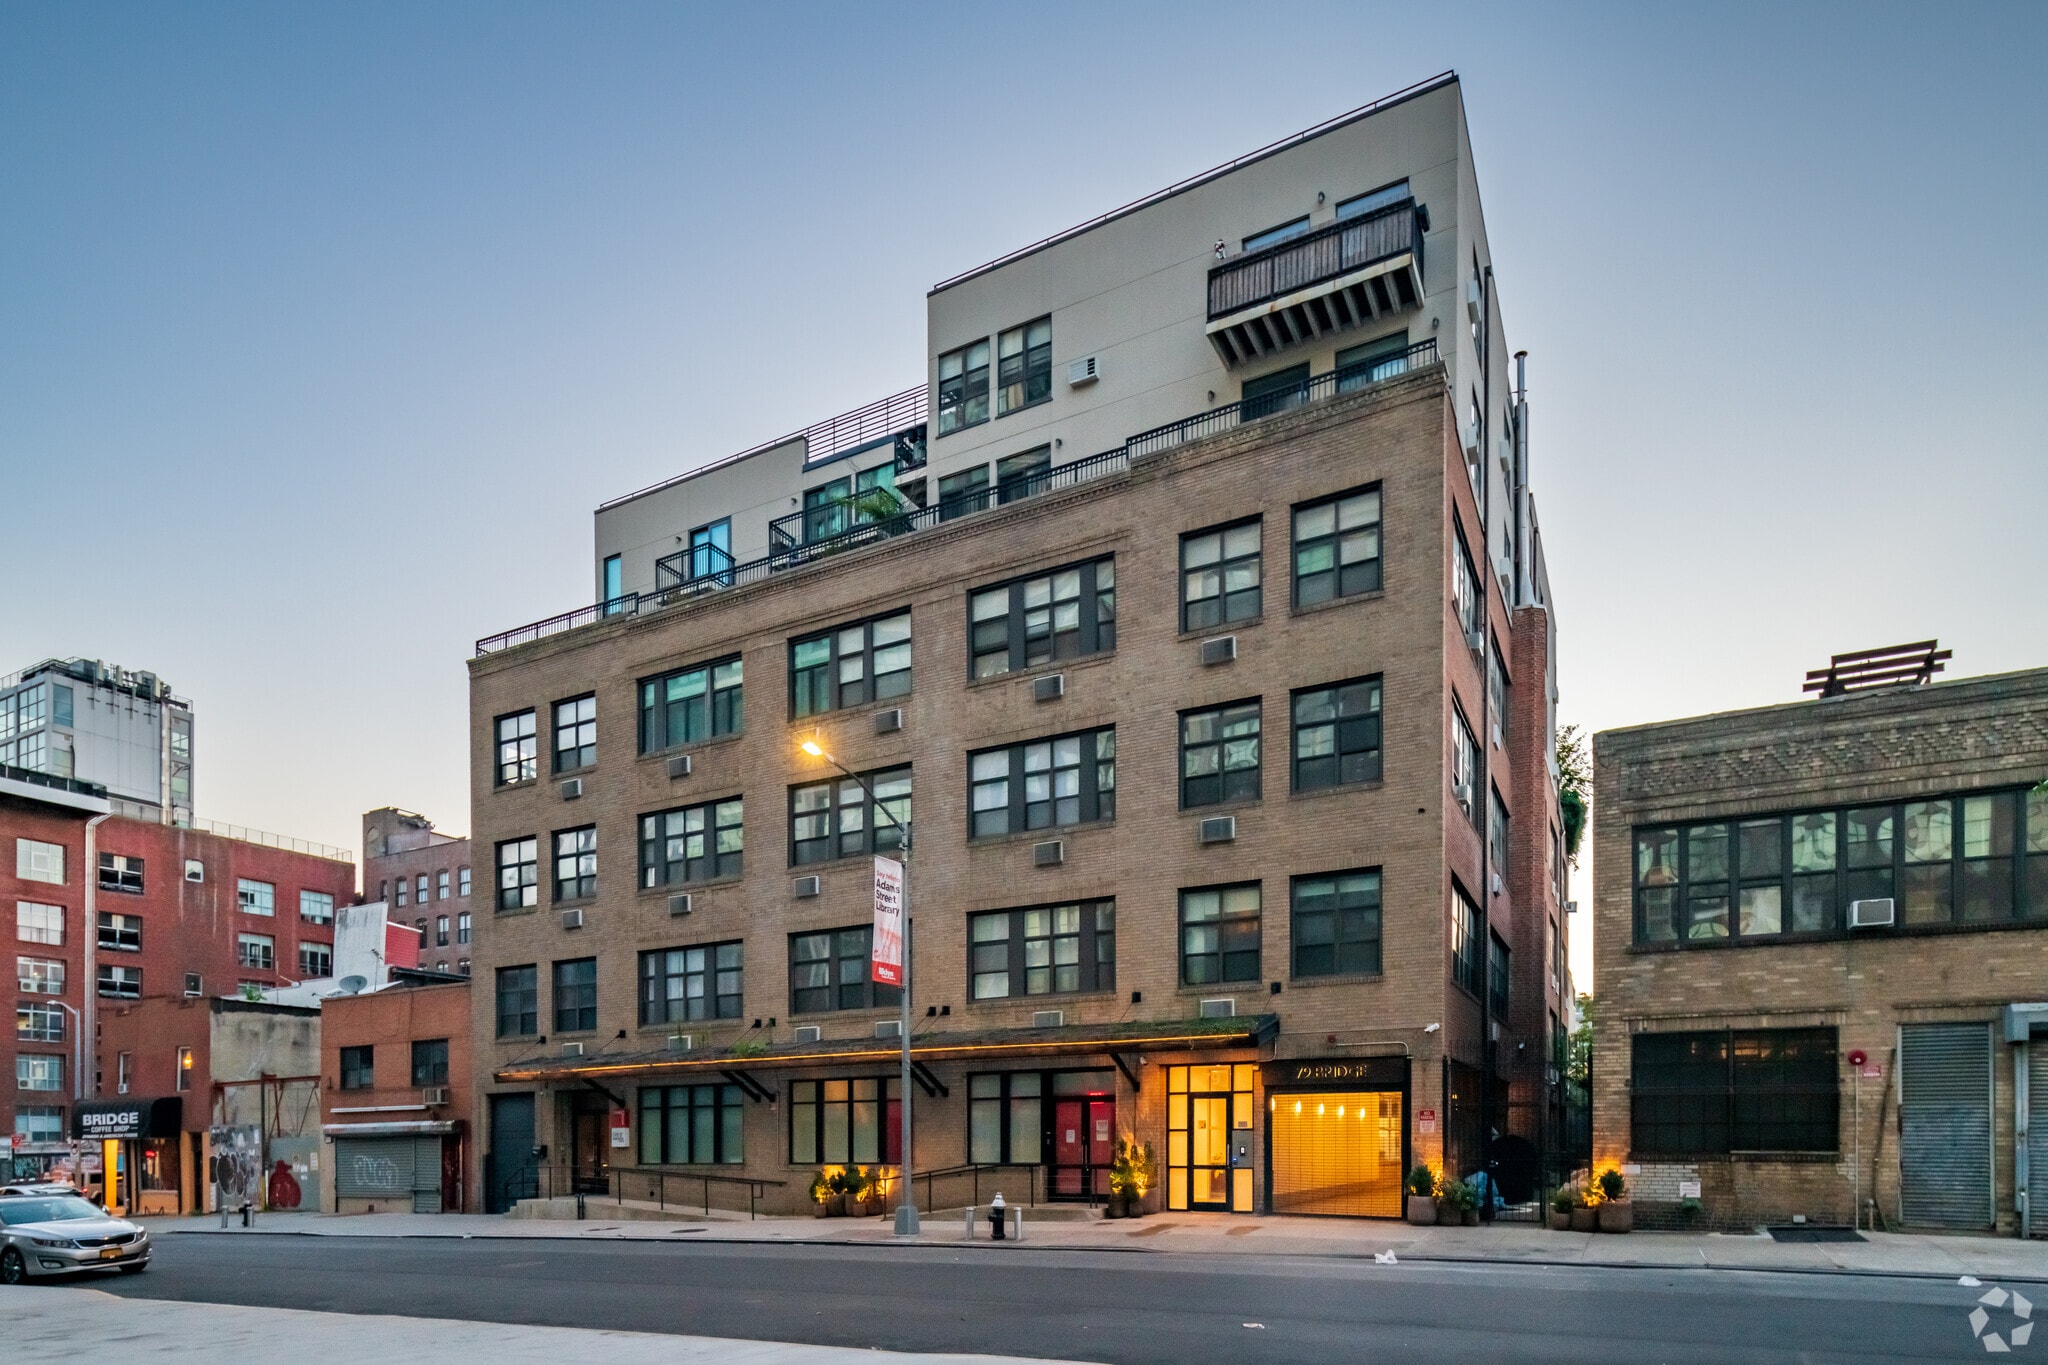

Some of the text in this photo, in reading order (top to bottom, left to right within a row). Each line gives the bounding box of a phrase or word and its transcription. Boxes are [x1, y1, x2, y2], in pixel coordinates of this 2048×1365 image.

[876, 878, 900, 894] Adams
[876, 889, 896, 904] Street
[876, 900, 900, 917] Library
[1296, 1064, 1367, 1079] 79 BRIDGE
[82, 1112, 139, 1126] BRIDGE
